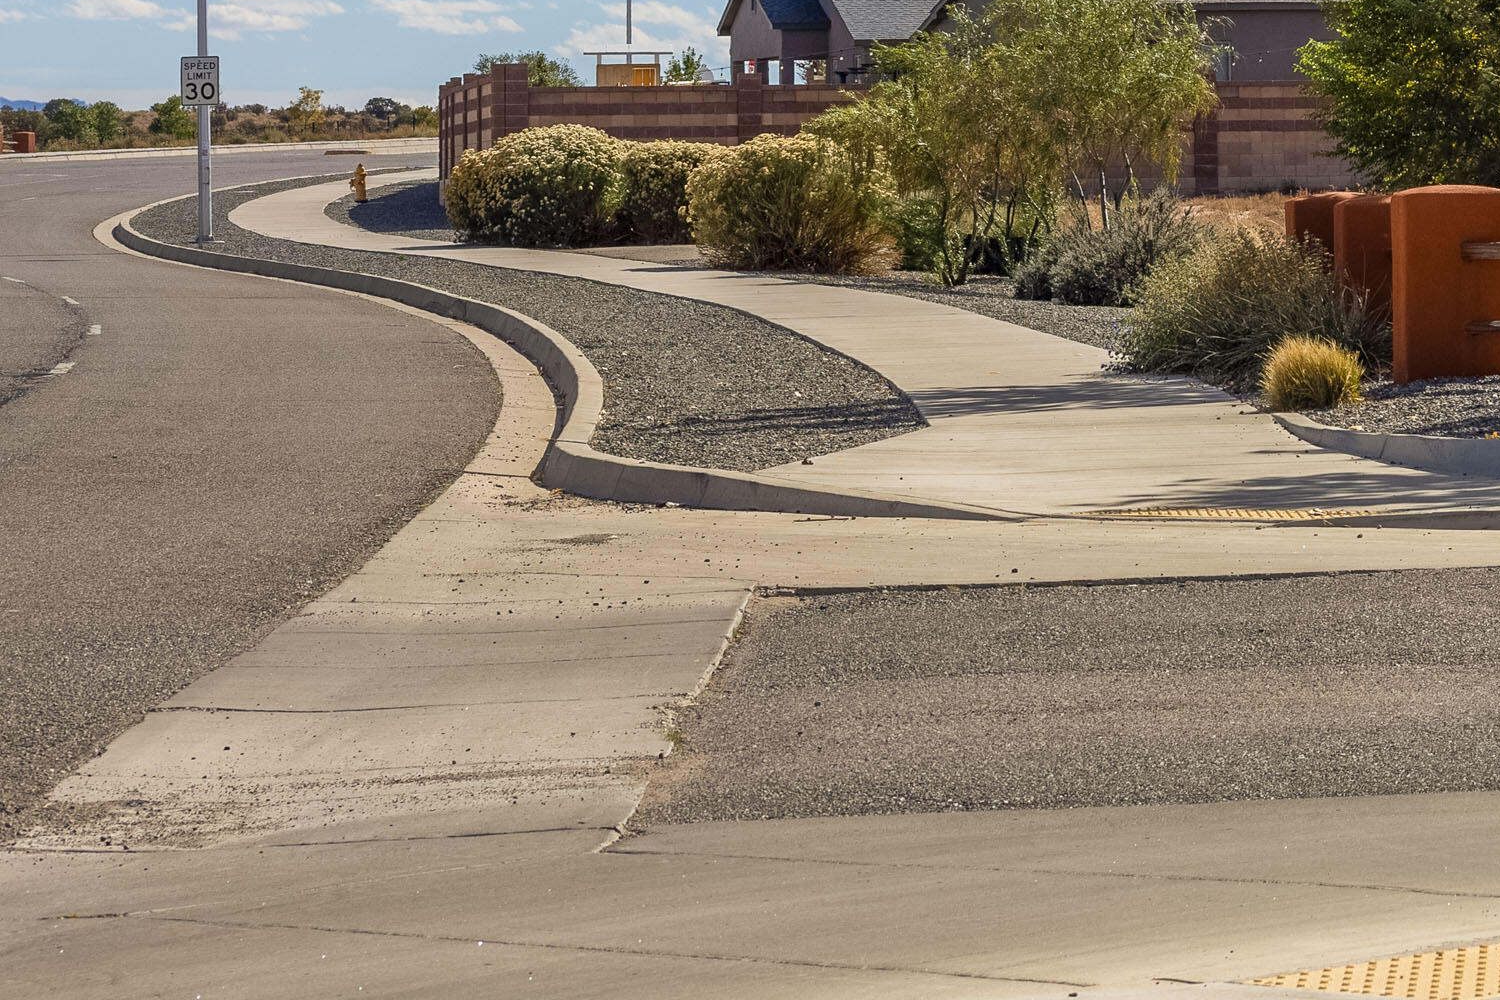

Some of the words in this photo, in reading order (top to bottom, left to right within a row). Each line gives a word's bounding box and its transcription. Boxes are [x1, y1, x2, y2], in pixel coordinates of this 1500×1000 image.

[184, 62, 216, 70] SPEED
[187, 72, 212, 80] LIMIT
[185, 82, 215, 100] 30
